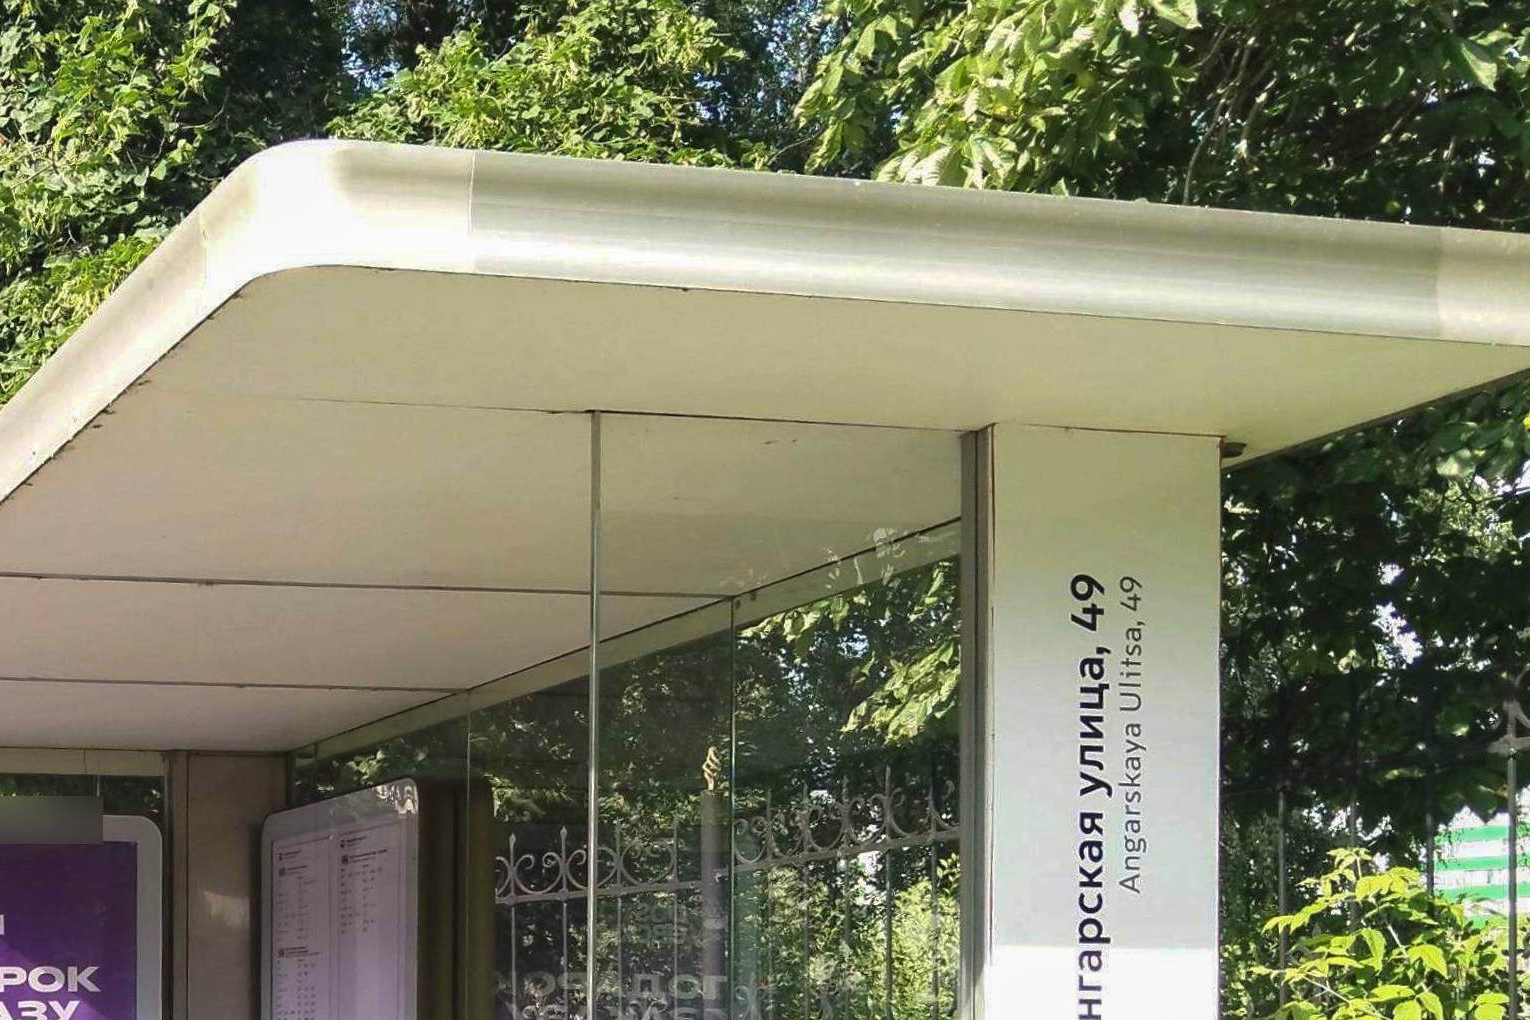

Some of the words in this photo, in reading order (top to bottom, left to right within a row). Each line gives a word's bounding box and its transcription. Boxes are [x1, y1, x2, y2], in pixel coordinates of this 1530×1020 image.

[1070, 574, 1105, 632] 49
[1120, 576, 1143, 611] 49
[1119, 620, 1146, 712] Ulitsa,
[1079, 646, 1113, 798] улица,
[1119, 723, 1147, 894] Angarskaya
